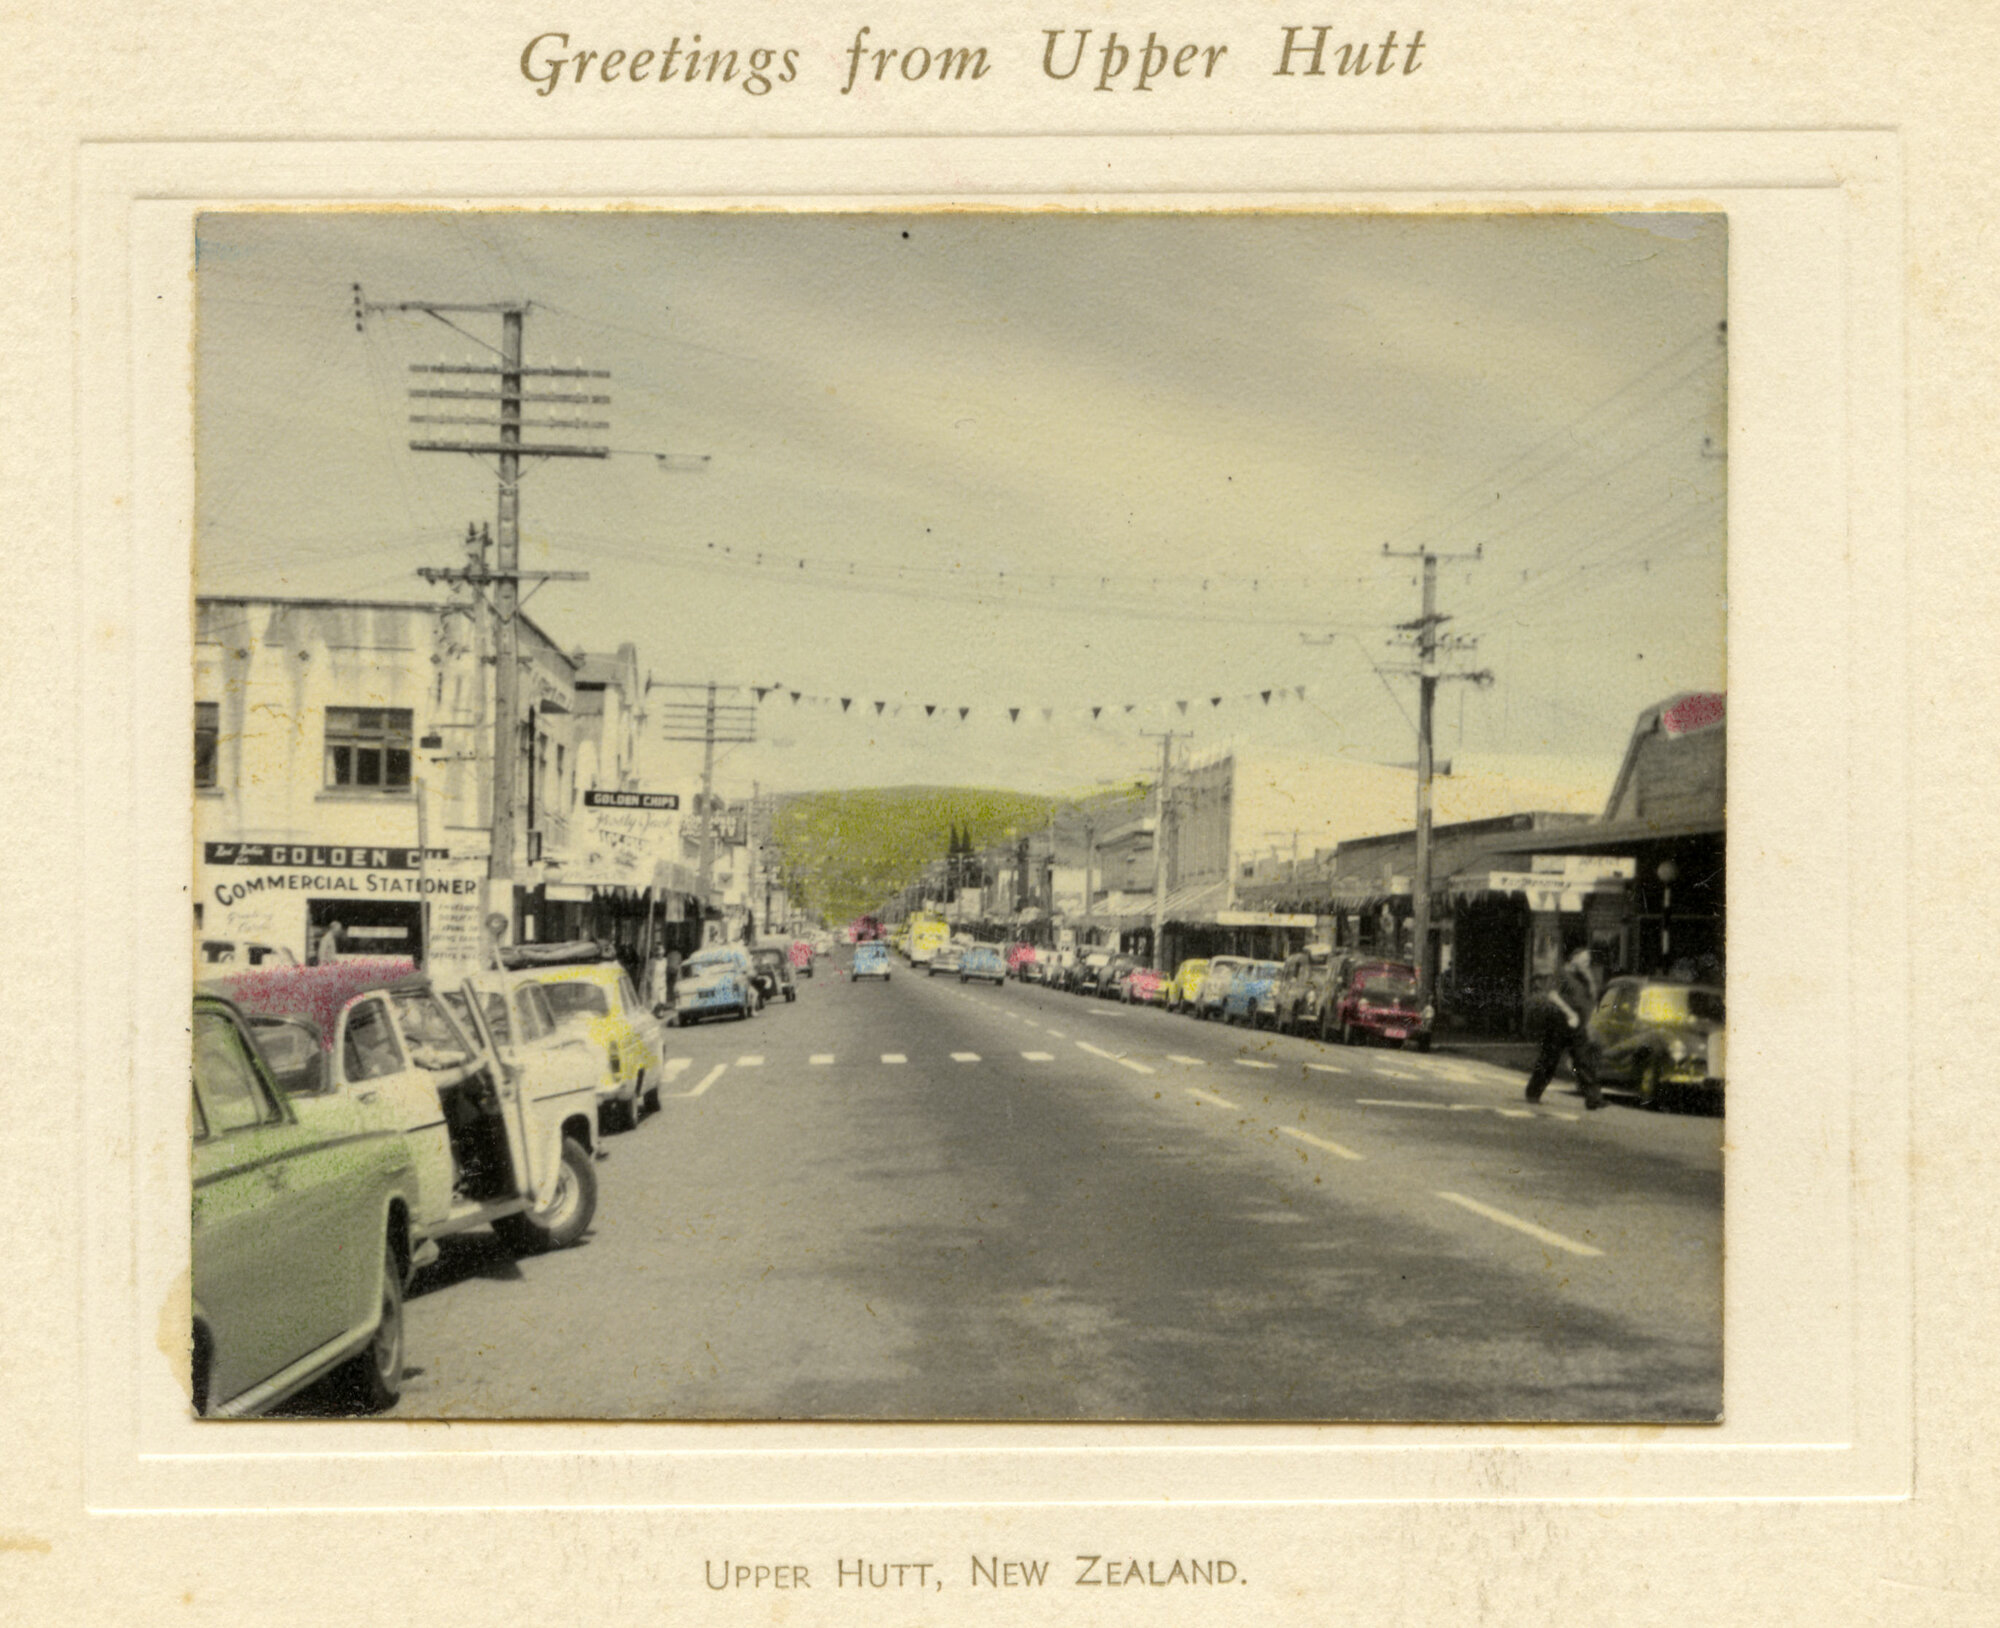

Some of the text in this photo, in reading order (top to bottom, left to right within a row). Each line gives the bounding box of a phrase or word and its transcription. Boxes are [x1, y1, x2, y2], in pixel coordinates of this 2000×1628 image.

[519, 23, 1427, 97] Greetings from Upper Hutt
[592, 792, 676, 809] GOLDEN CHIPS
[271, 847, 388, 867] GOLDEN
[214, 874, 477, 907] COMMERCIAL STATIONER
[705, 1559, 810, 1591] UPPER
[971, 1554, 1050, 1588] NEW
